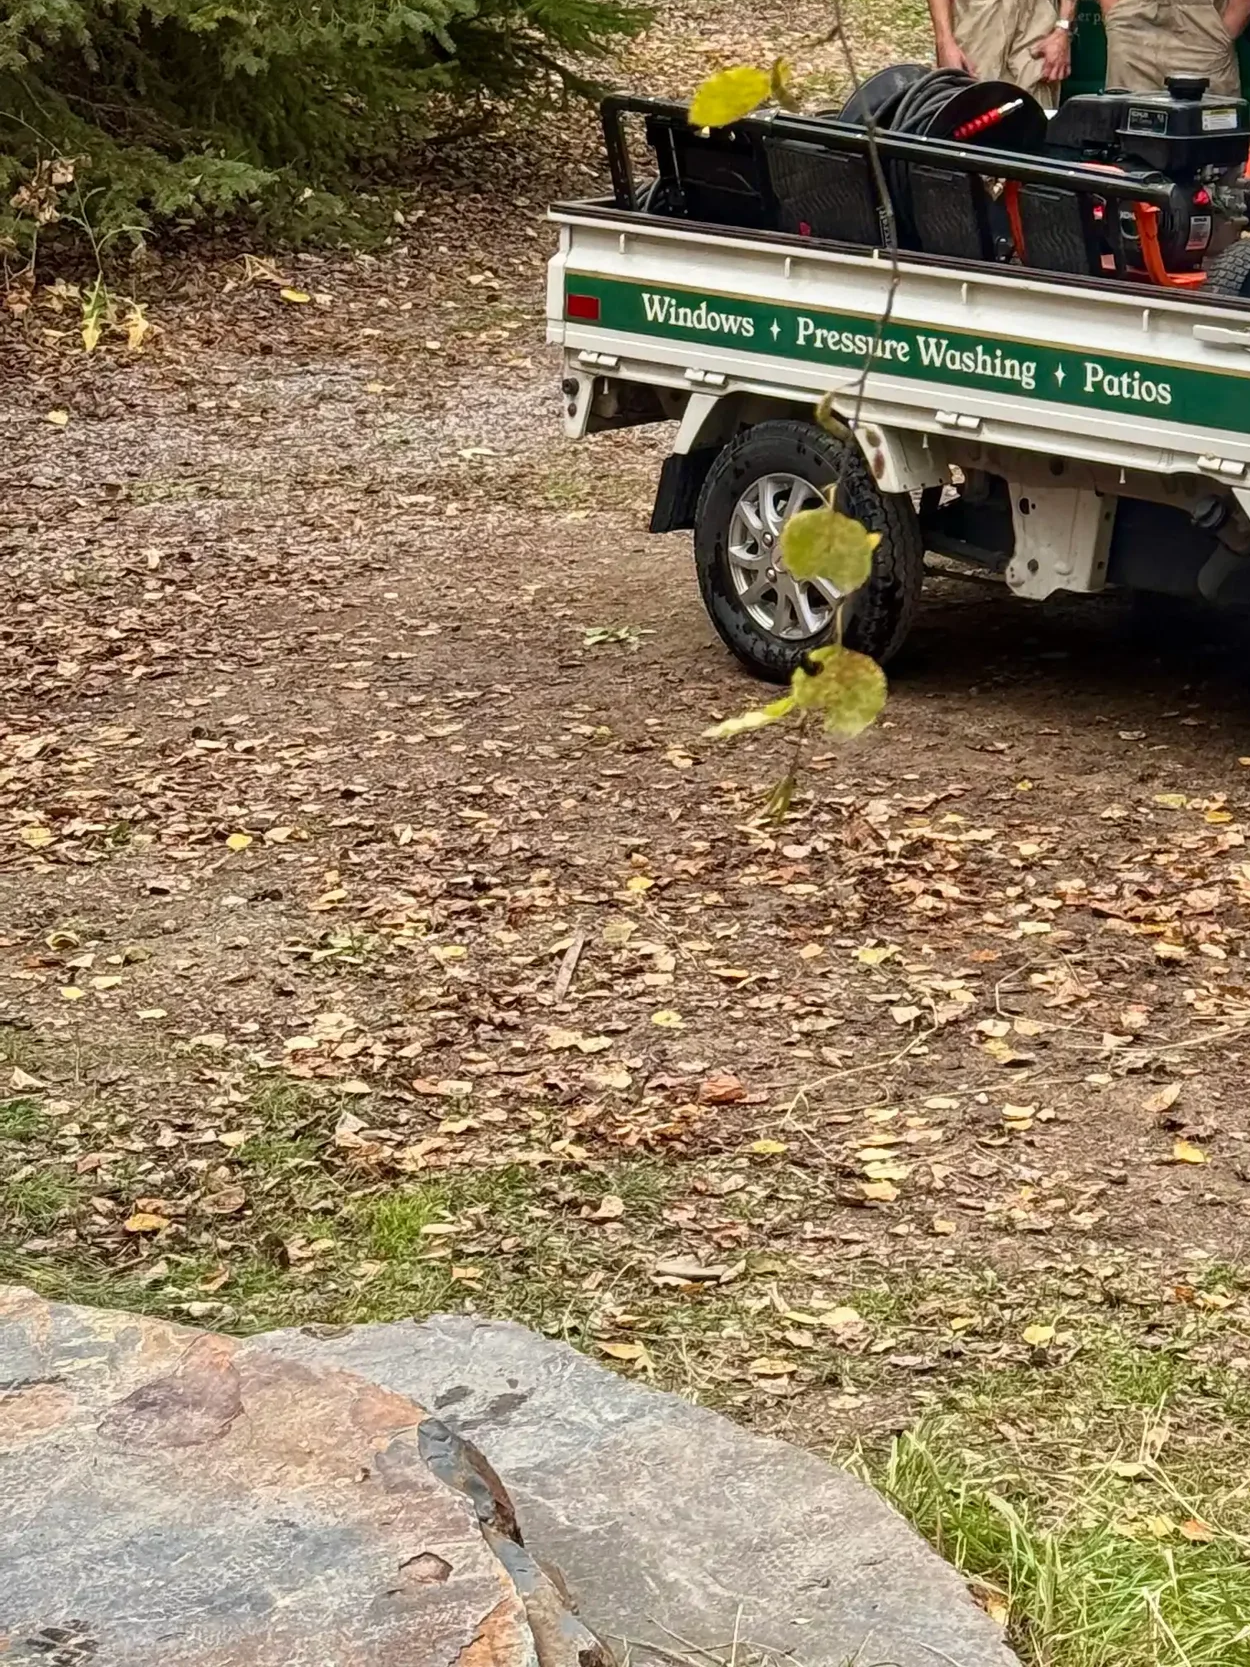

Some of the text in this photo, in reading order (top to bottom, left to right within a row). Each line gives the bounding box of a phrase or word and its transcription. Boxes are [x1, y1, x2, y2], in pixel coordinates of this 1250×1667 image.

[641, 293, 1172, 405] Windows Pressure Washing Patios
